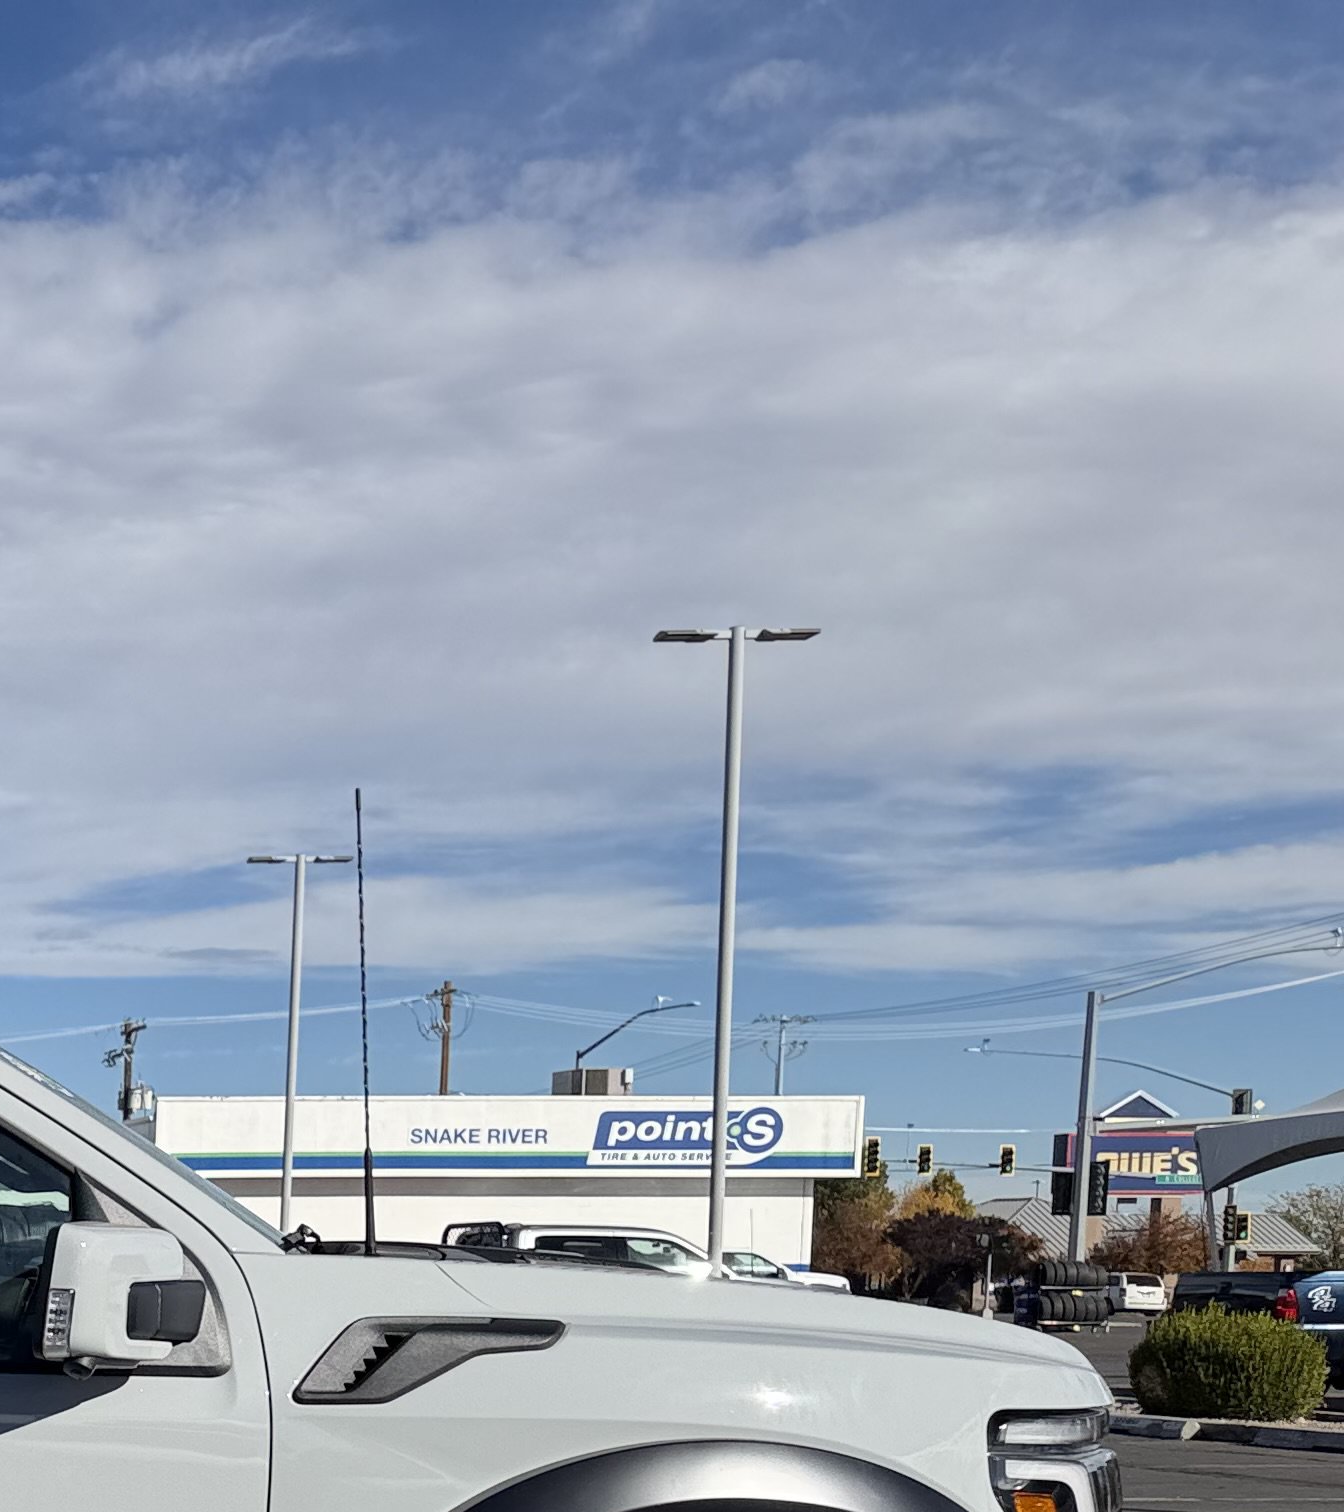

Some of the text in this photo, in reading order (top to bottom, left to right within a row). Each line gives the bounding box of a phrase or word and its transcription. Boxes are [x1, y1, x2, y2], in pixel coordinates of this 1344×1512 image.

[410, 1127, 548, 1145] SNAKE RIVER
[606, 1114, 714, 1146] point
[600, 1152, 733, 1161] TIRE & AUTO SERVE
